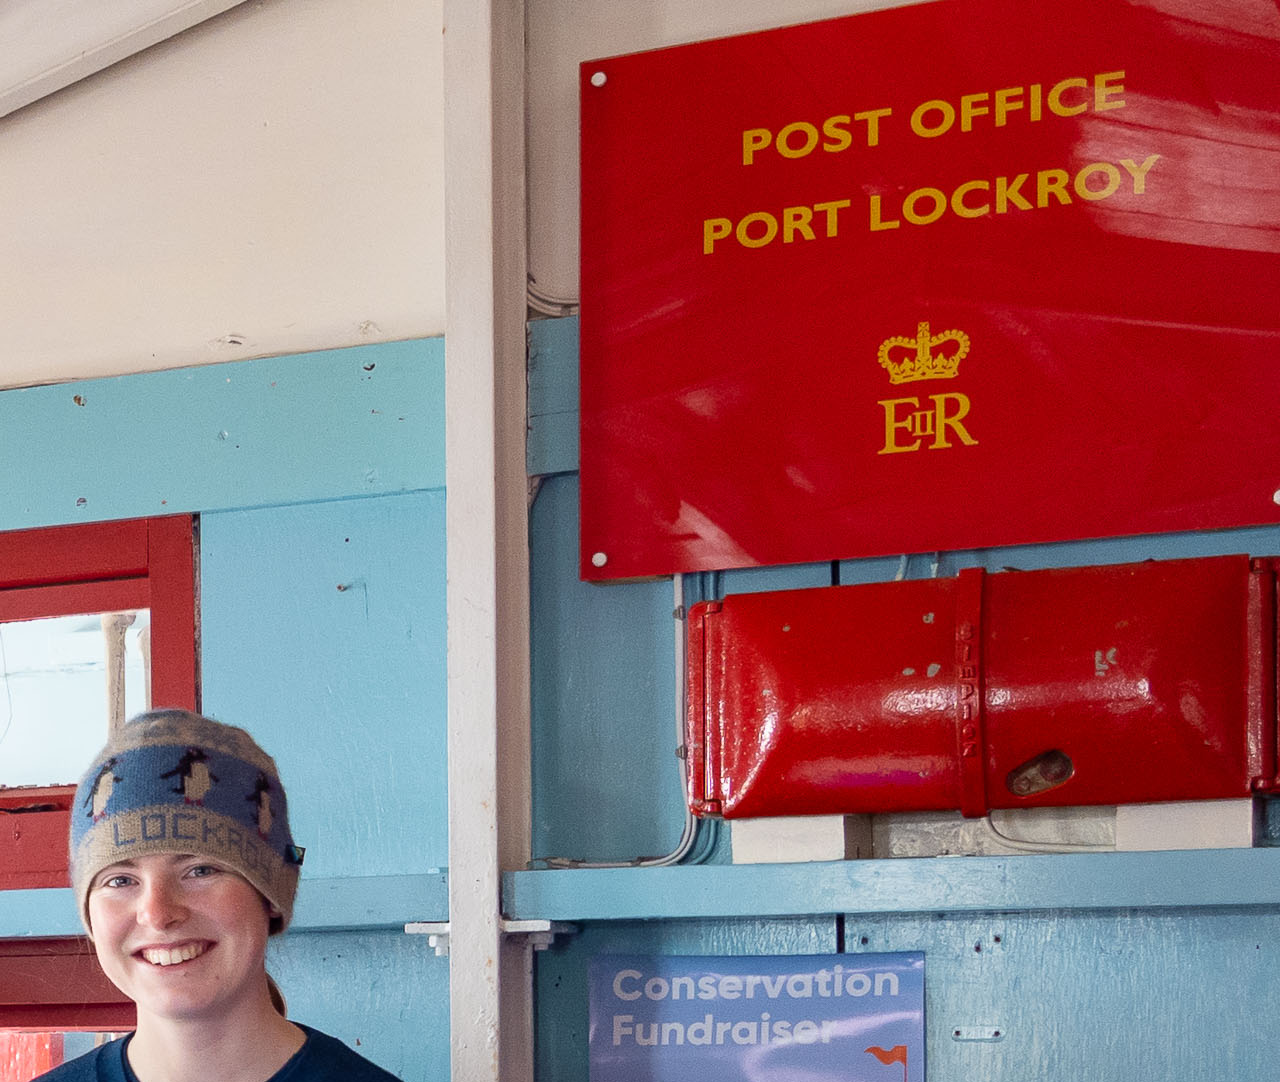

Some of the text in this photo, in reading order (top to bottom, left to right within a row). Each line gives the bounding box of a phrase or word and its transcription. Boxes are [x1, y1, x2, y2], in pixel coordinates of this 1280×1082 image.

[743, 70, 1126, 166] POST OFFICE
[703, 154, 1163, 255] PORT LOCKROY
[612, 964, 900, 1001] Conservation
[612, 1013, 838, 1046] Fundraiser
